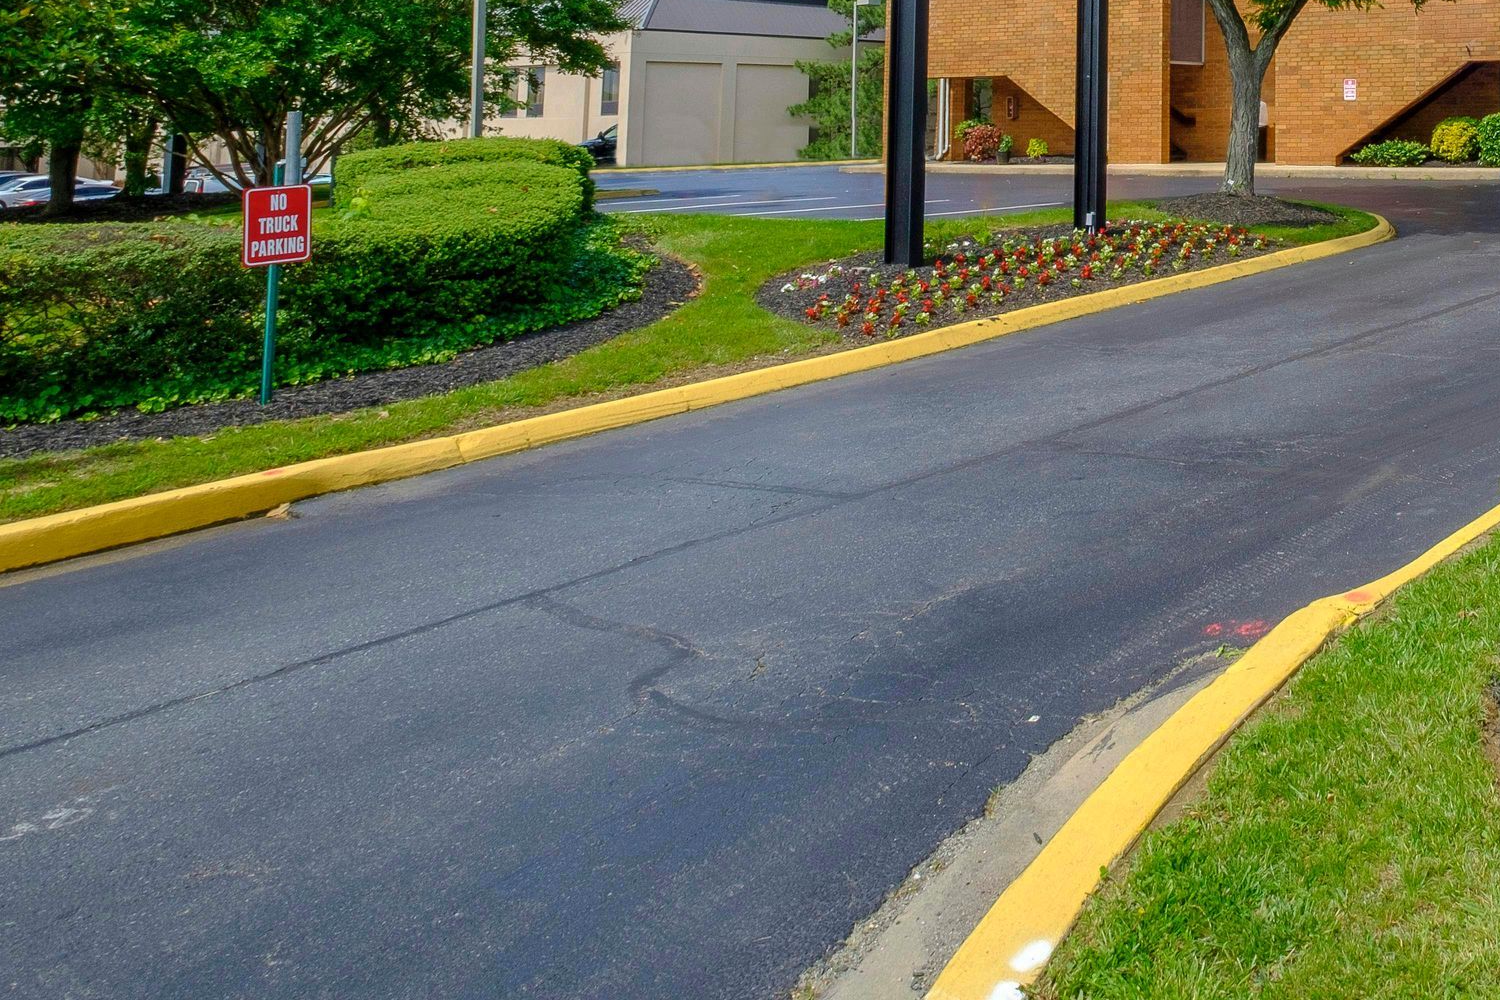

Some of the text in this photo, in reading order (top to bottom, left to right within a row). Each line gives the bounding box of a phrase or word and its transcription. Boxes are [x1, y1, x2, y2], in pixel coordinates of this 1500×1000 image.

[270, 193, 287, 211] NO
[258, 214, 298, 234] TRUCK
[251, 236, 304, 258] PARKING
